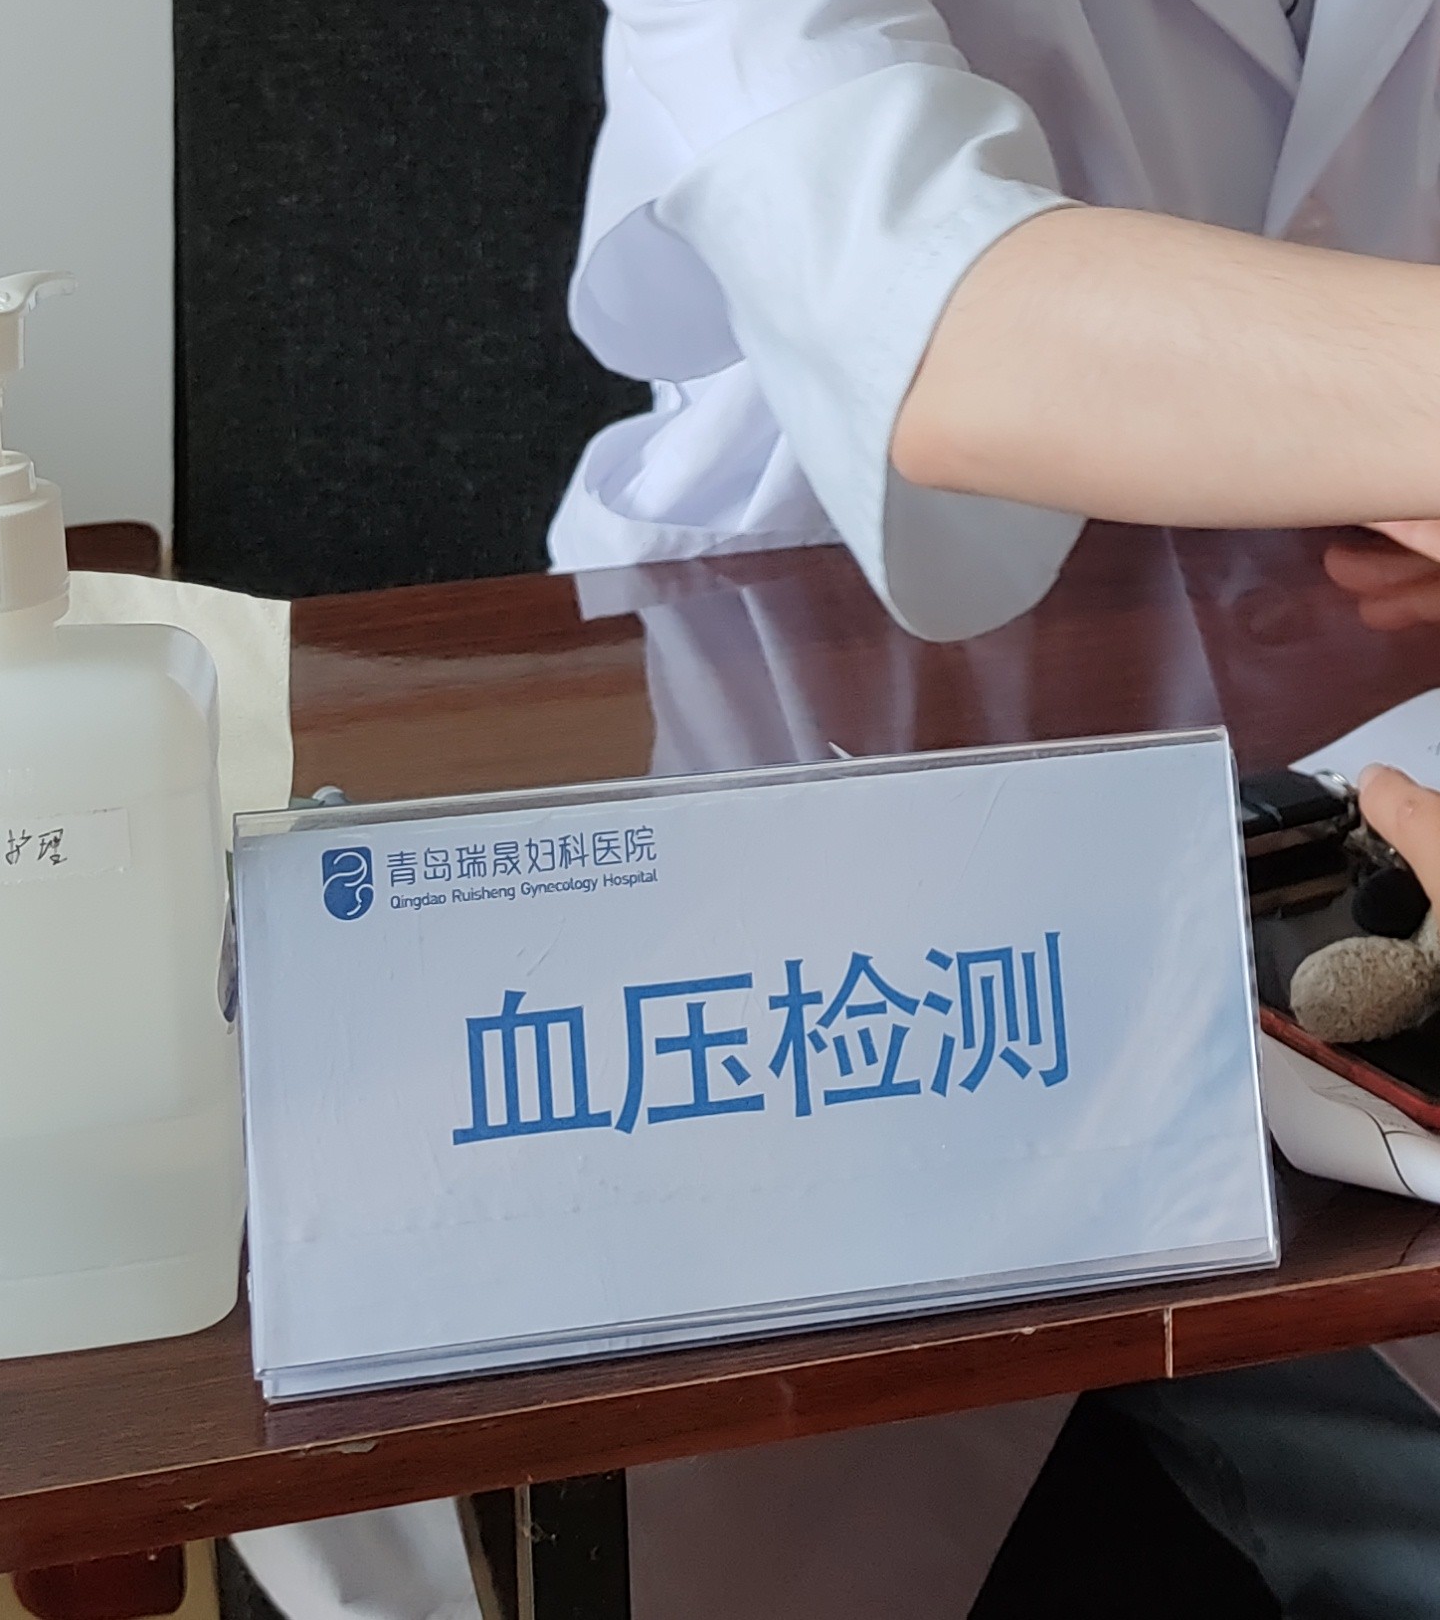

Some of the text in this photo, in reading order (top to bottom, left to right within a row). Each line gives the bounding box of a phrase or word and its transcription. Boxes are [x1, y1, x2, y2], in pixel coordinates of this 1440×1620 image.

[386, 825, 658, 888] 青岛瑞晟妇科医院
[390, 868, 659, 911] Qingdao Ruisheng Gynecology Hospital
[452, 931, 1070, 1146] 血压检测
